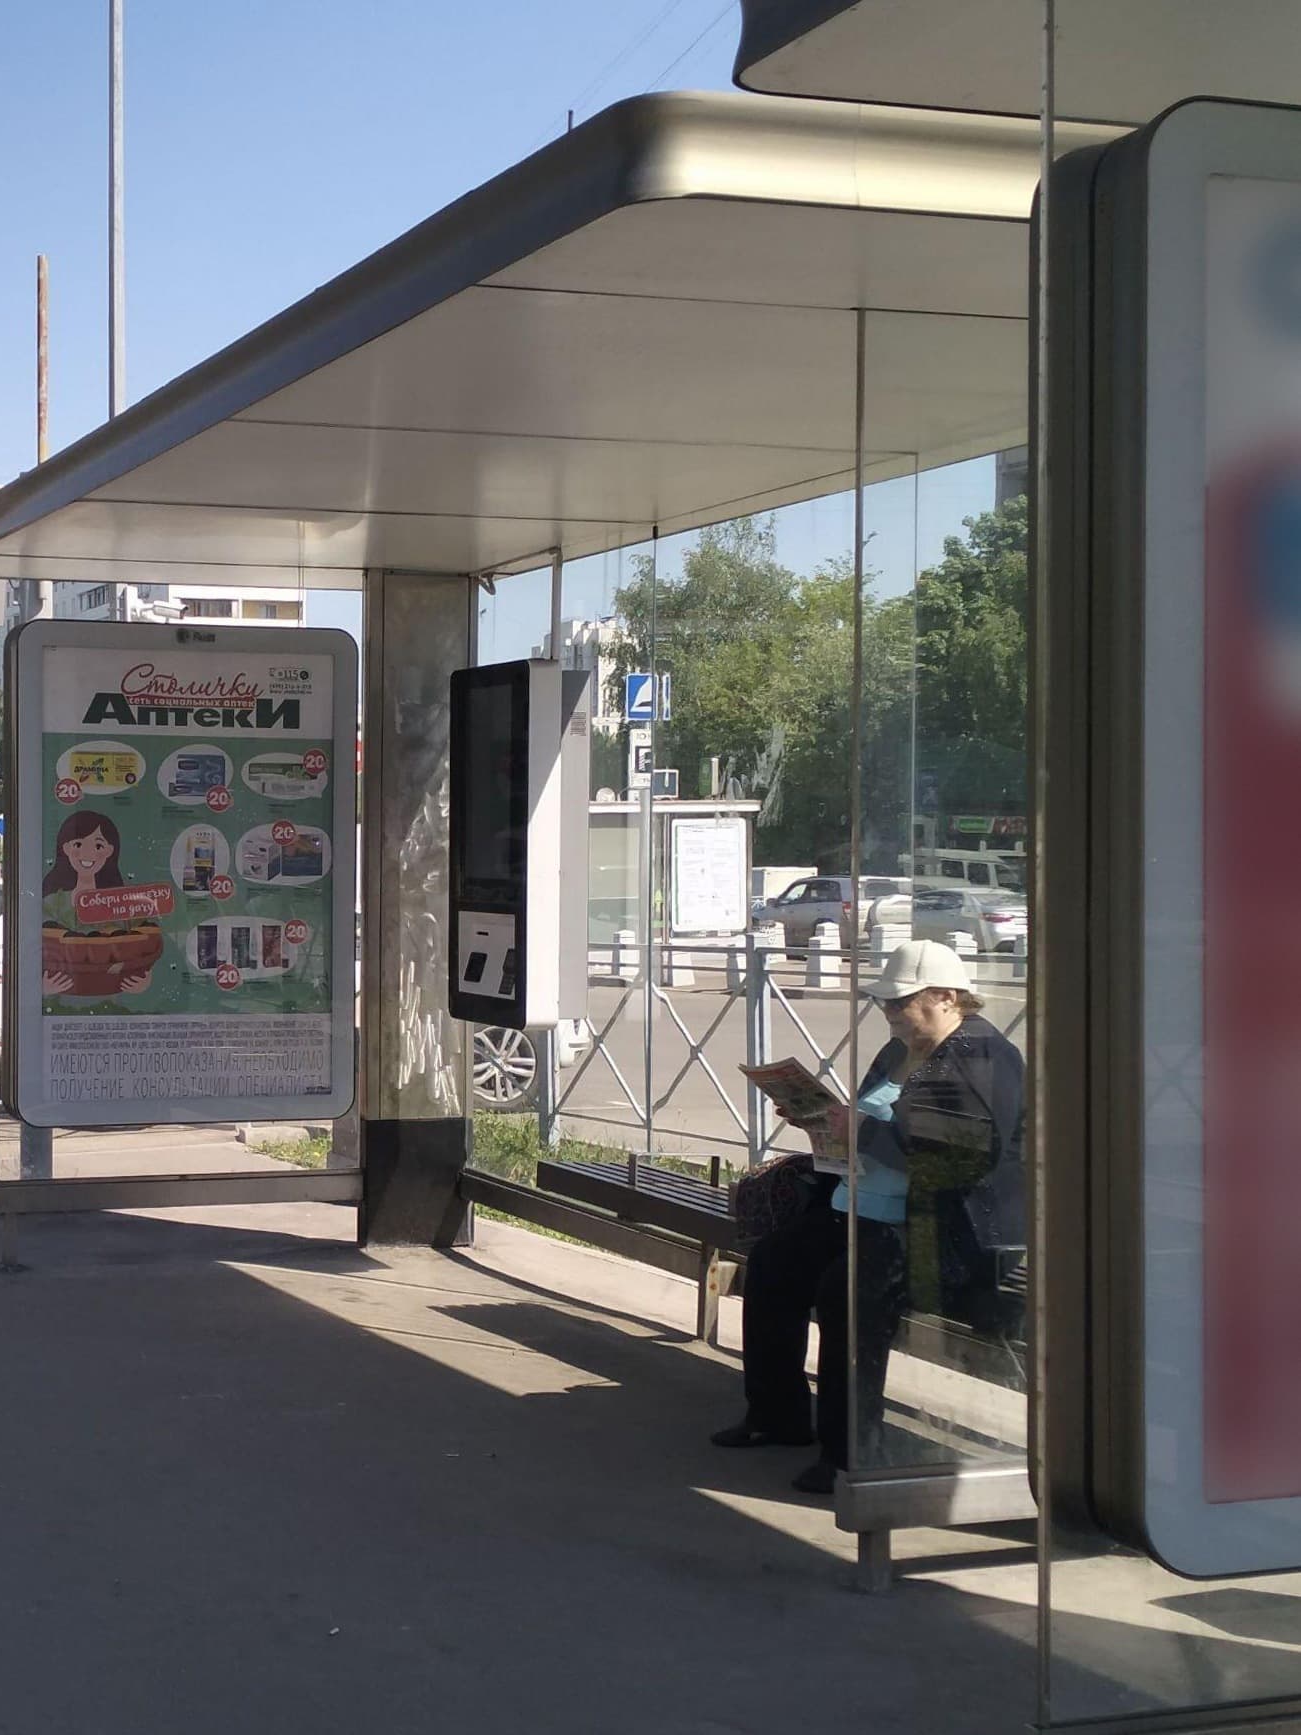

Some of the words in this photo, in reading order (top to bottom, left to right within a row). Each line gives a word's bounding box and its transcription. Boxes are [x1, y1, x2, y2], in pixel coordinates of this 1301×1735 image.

[120, 663, 265, 698] Столички
[154, 697, 220, 707] социальных
[306, 755, 324, 768] 20
[58, 784, 78, 798] 20
[209, 792, 228, 805] 20
[274, 827, 292, 840] 20
[212, 880, 231, 894] 20
[80, 892, 120, 908] Собери
[112, 905, 127, 915] на
[287, 924, 306, 938] 20
[217, 969, 238, 984] 20
[50, 1052, 110, 1075] ИМЕЮТСЯ
[244, 1050, 324, 1072] НЕОБХОДИМО
[50, 1078, 125, 1100] ПОЛУЧЕНИЕ
[132, 1076, 230, 1099] КОНСУЛЬТАЦИИ
